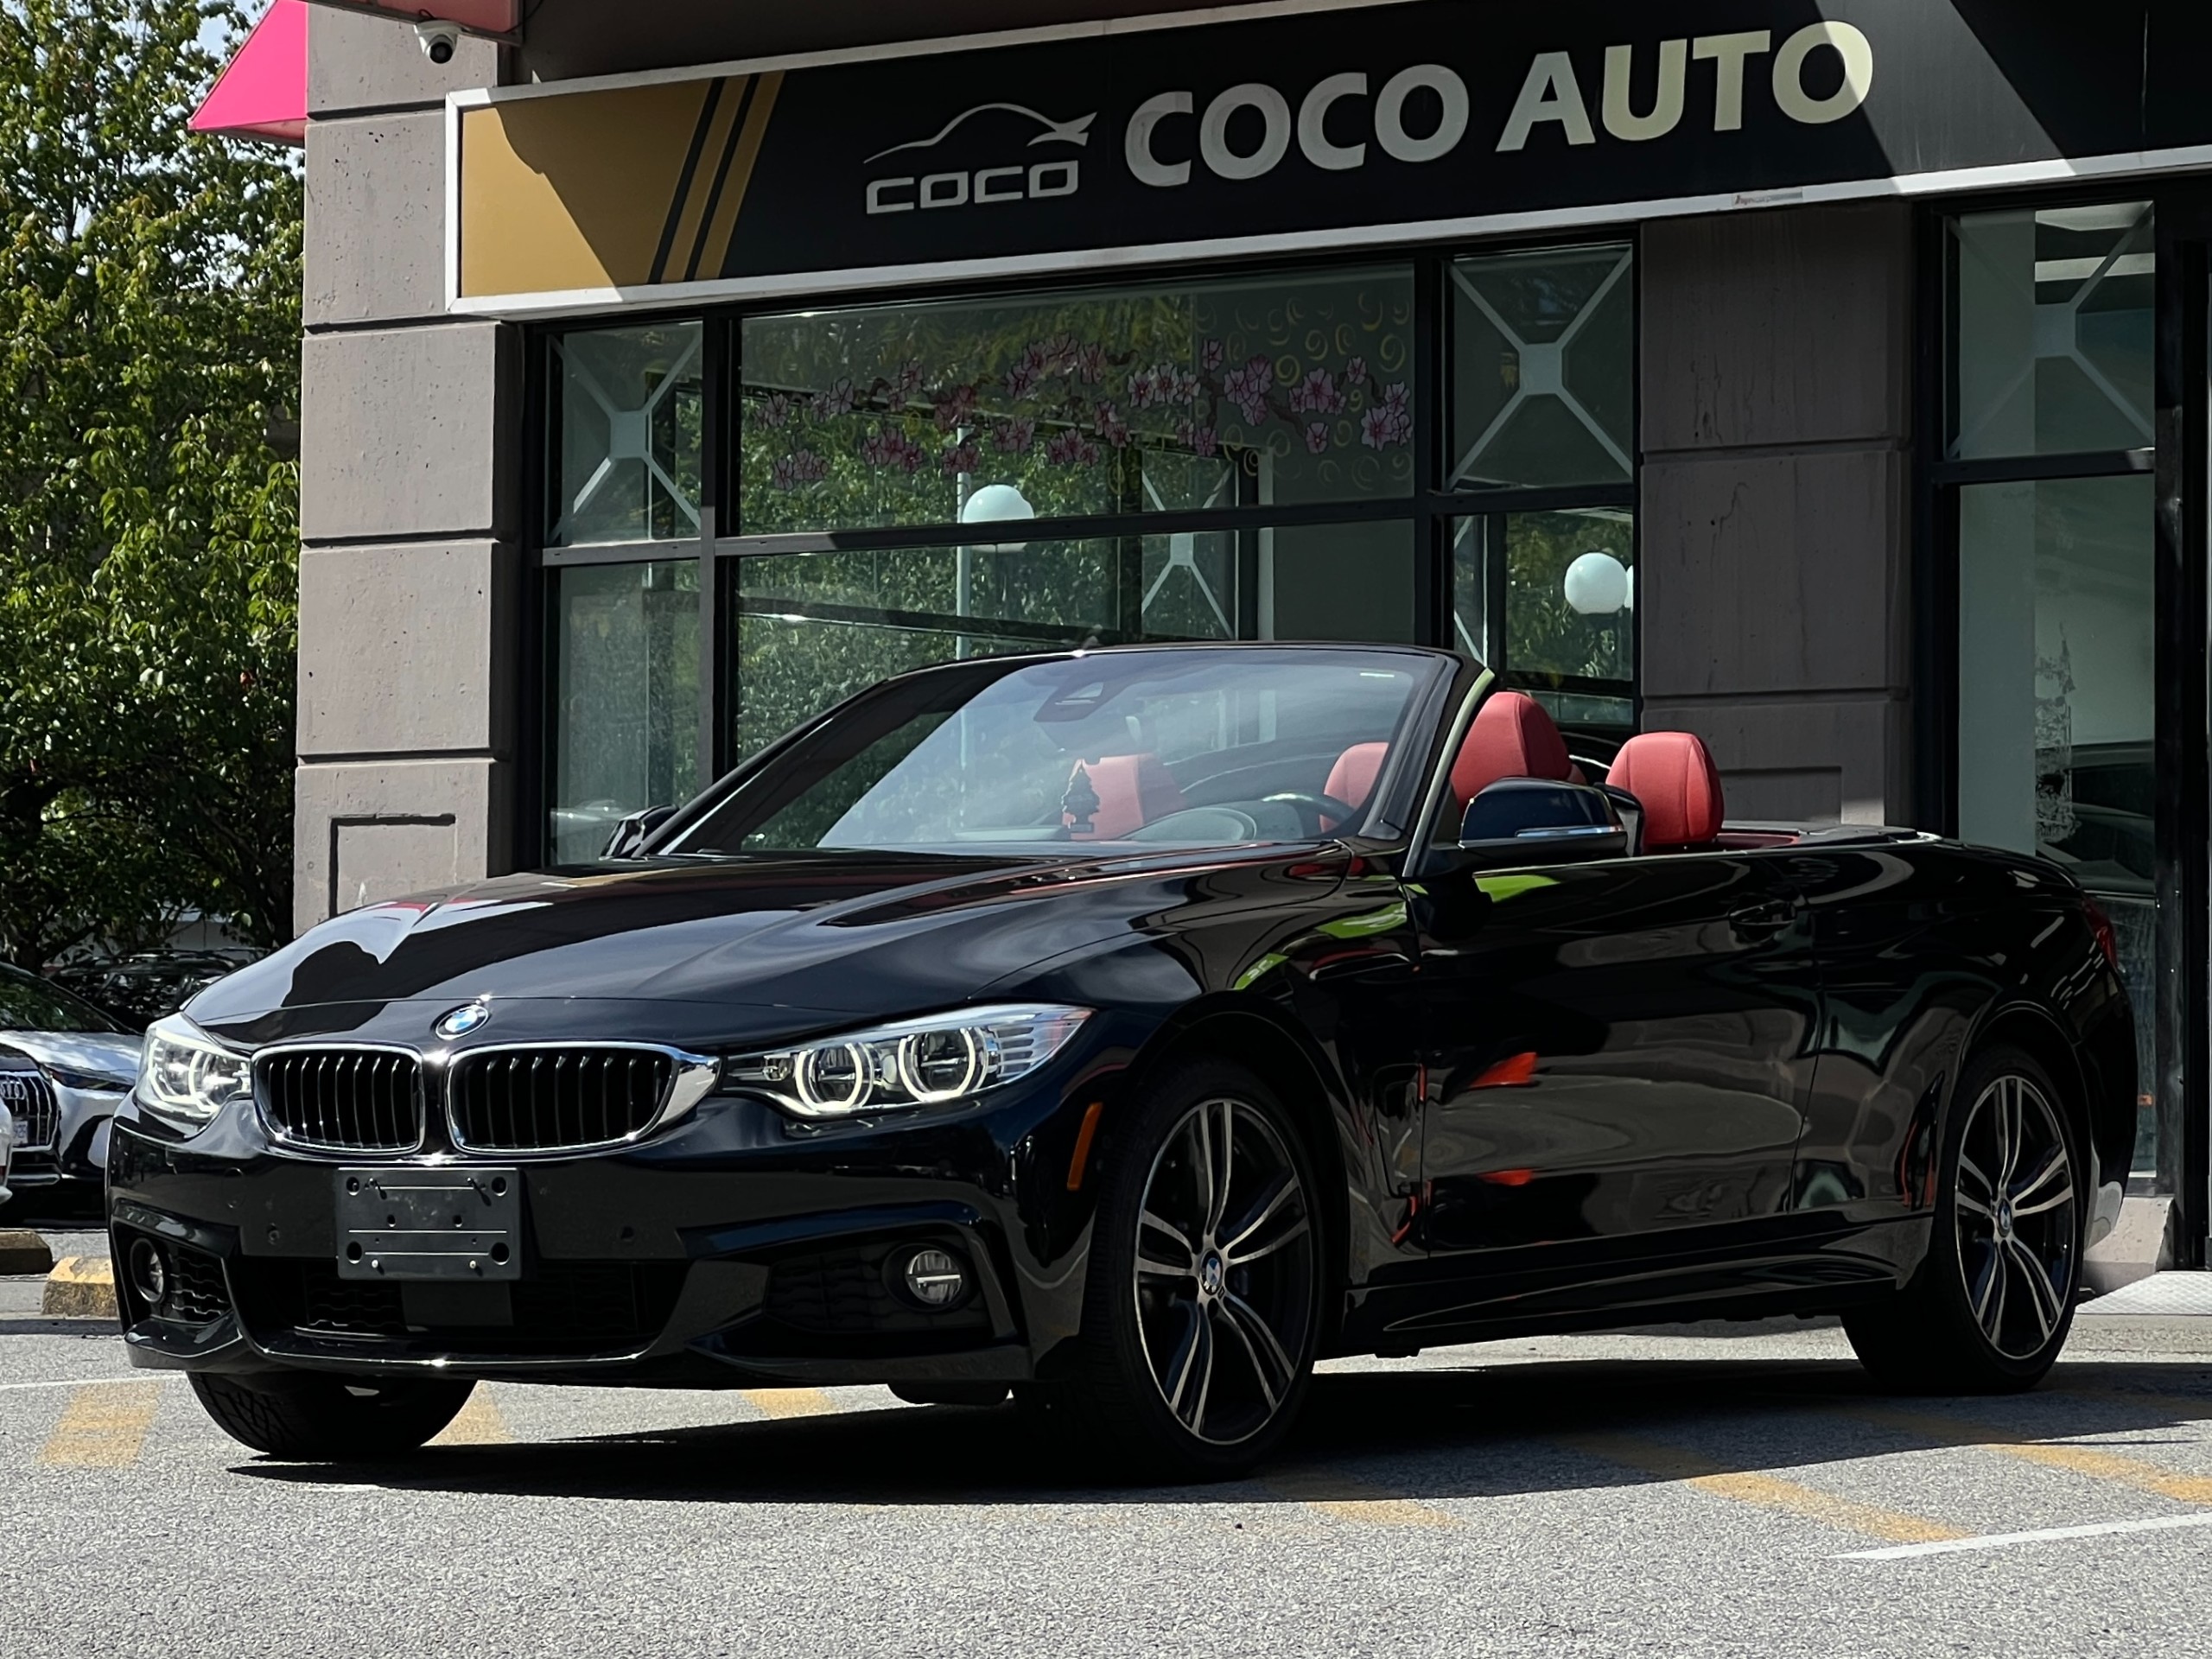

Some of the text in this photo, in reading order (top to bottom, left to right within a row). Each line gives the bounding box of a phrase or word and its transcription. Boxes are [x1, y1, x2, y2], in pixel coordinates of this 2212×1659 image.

[1126, 21, 1874, 187] COCO AUTO
[866, 161, 1078, 214] COCO
